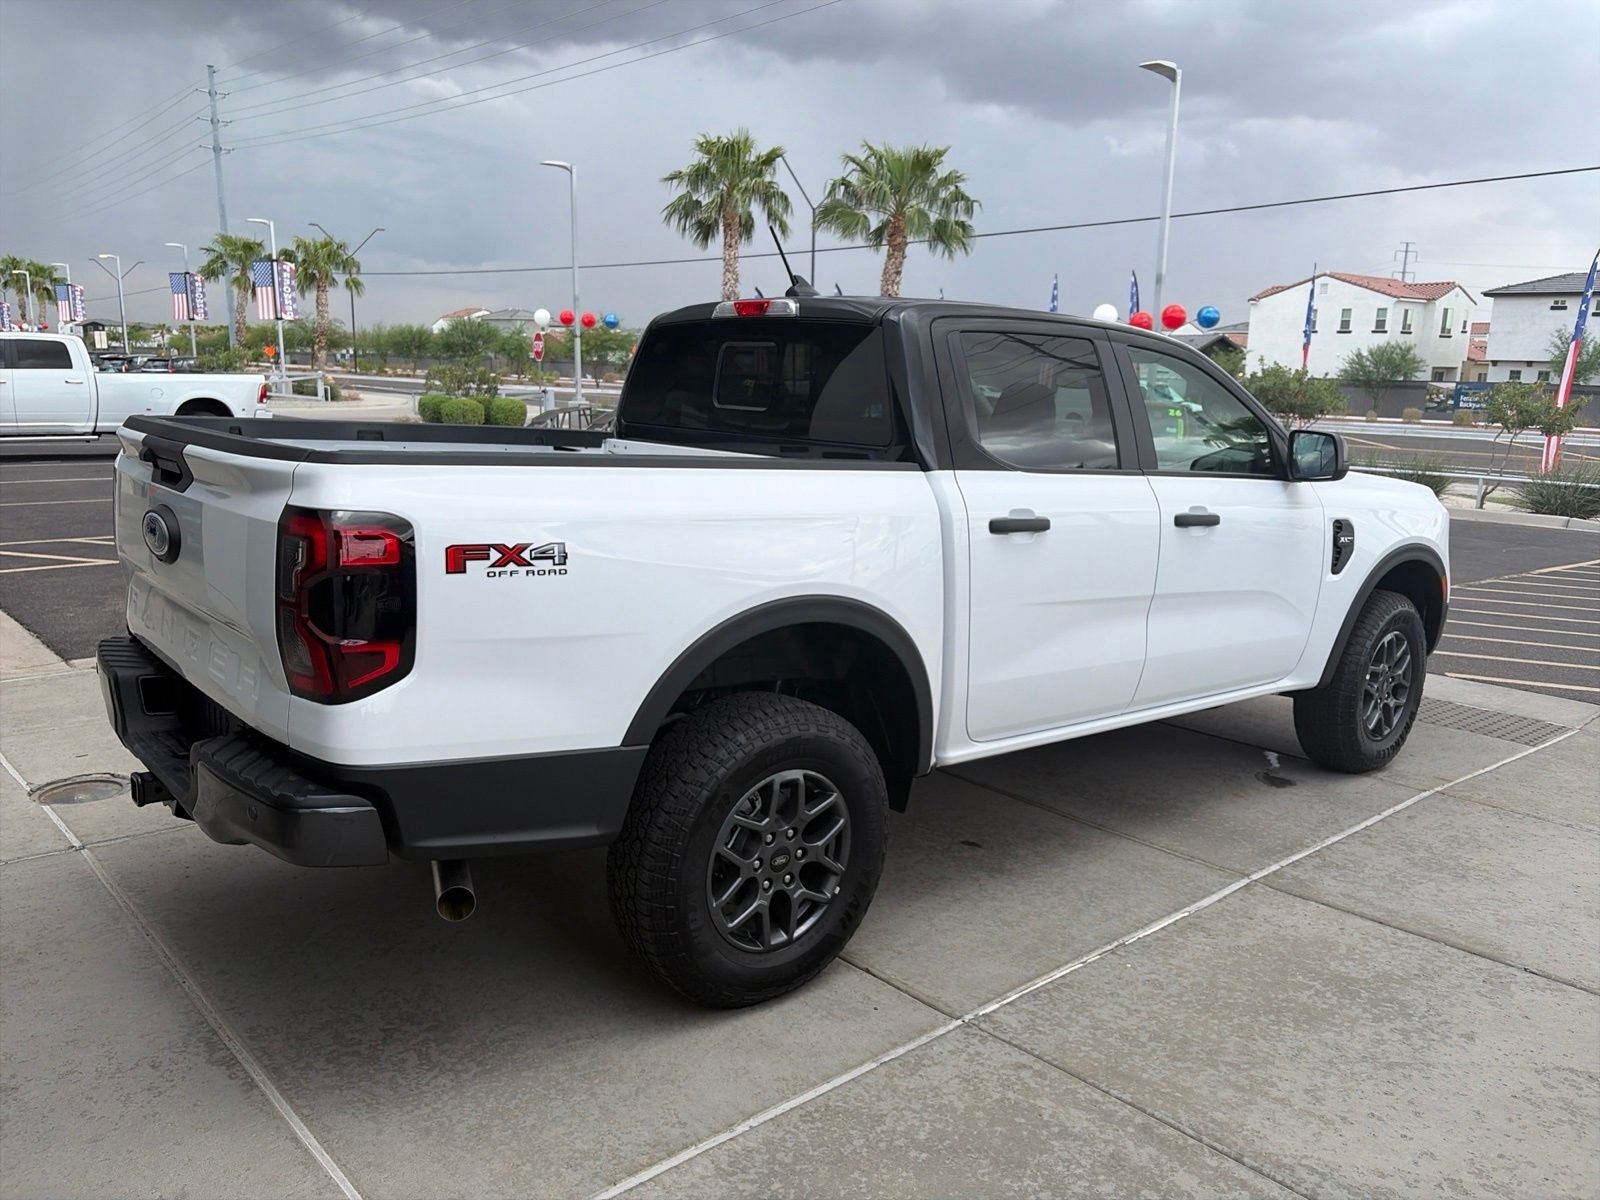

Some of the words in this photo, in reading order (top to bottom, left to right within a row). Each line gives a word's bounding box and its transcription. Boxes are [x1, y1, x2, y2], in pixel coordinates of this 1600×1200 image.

[445, 542, 568, 575] FX4
[486, 569, 519, 578] OFF
[526, 568, 568, 577] ROAD
